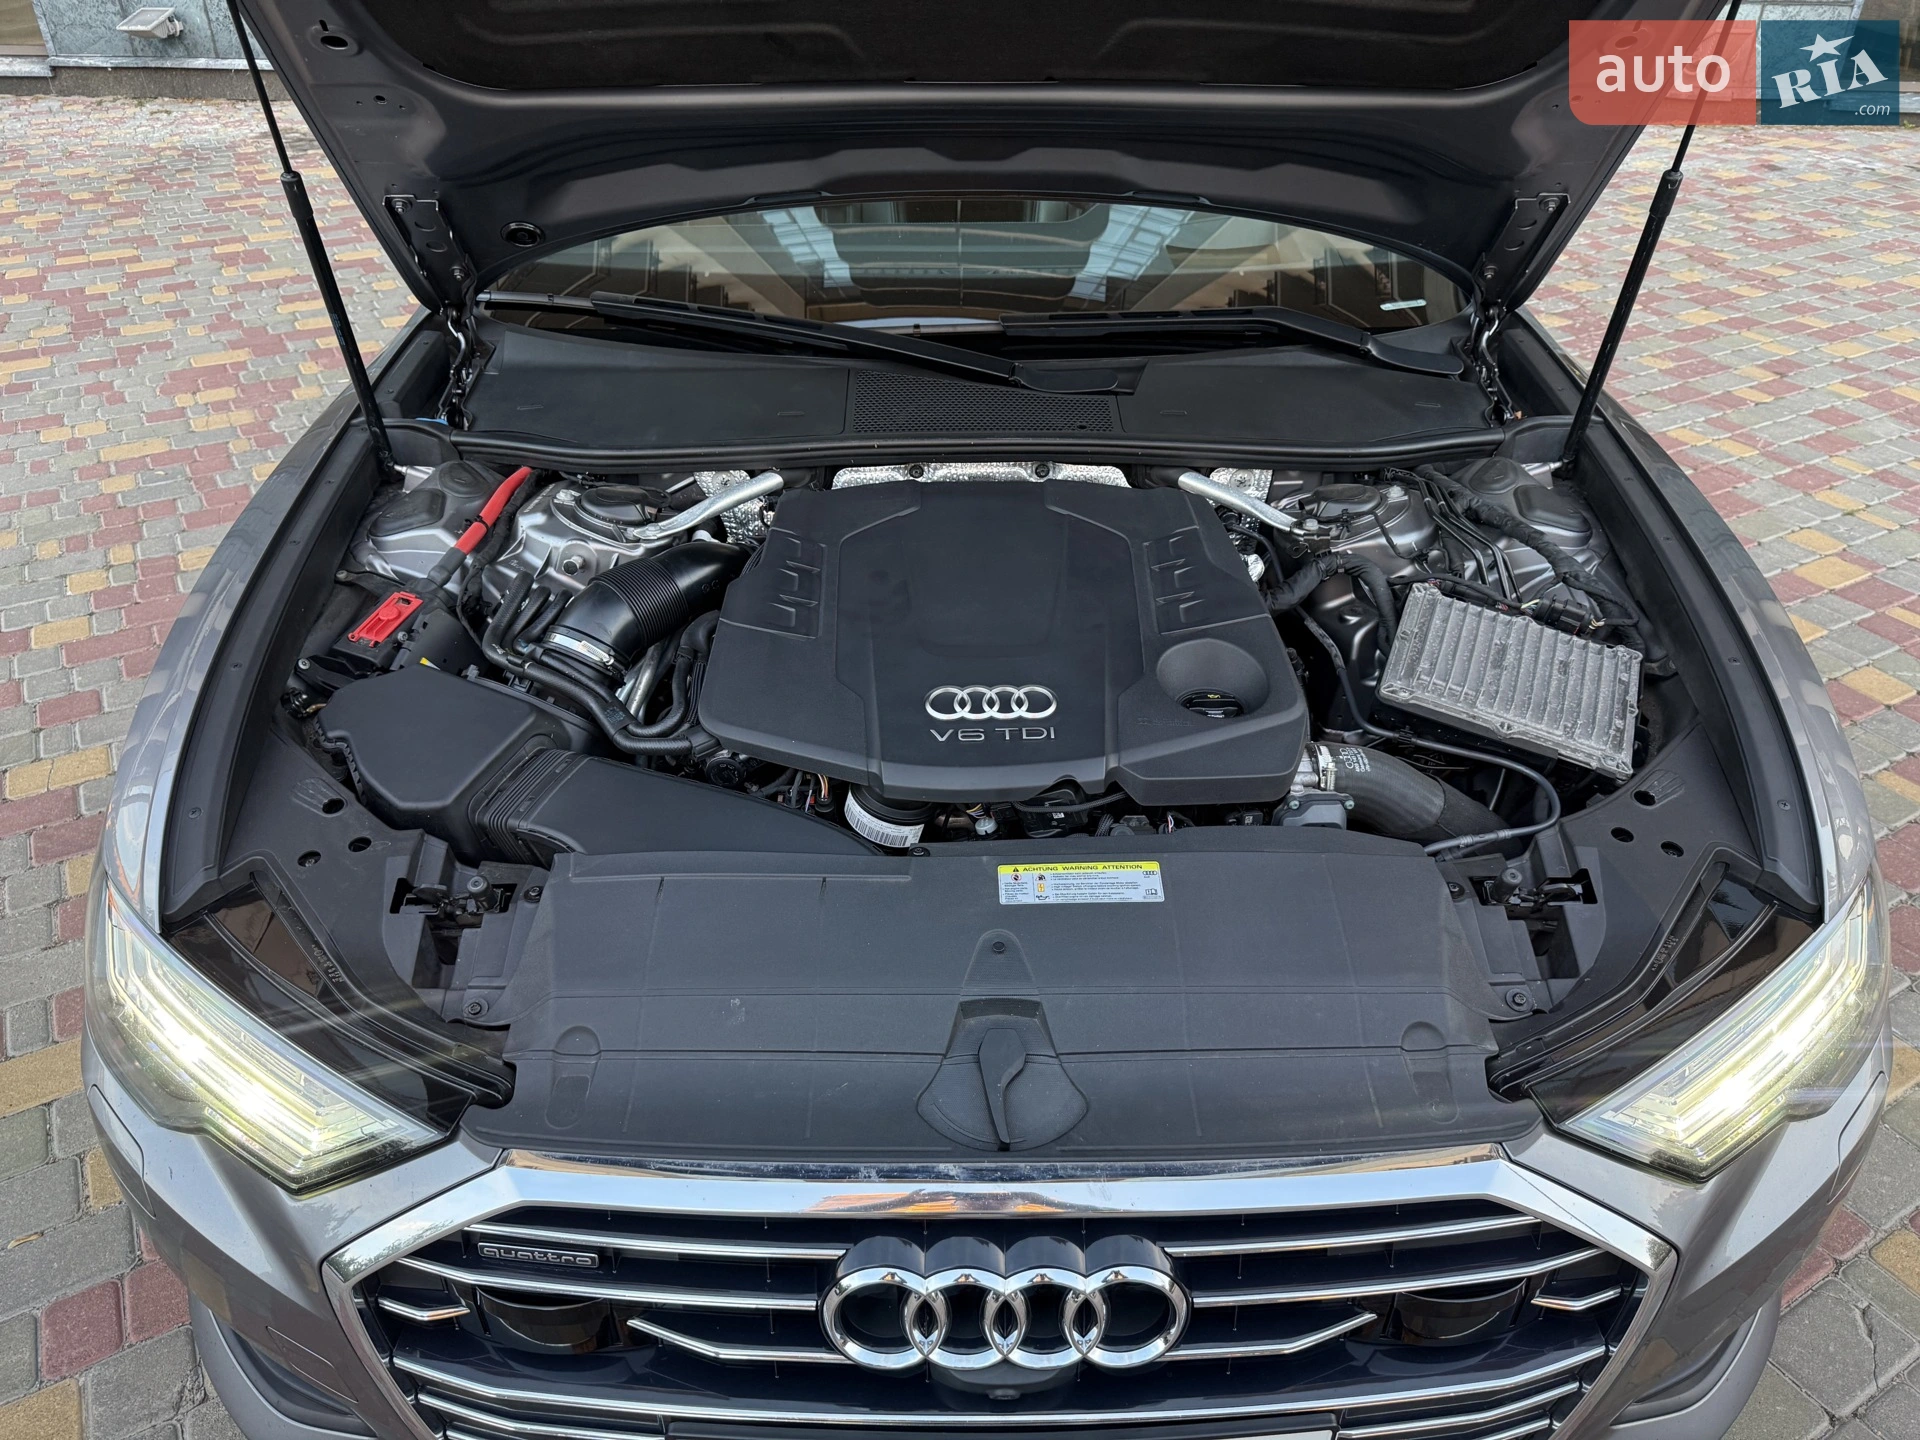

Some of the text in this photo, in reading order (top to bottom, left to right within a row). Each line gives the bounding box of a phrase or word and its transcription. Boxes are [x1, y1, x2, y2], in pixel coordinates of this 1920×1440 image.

[929, 726, 1055, 742] V6 TDI
[483, 1247, 592, 1265] quattro
